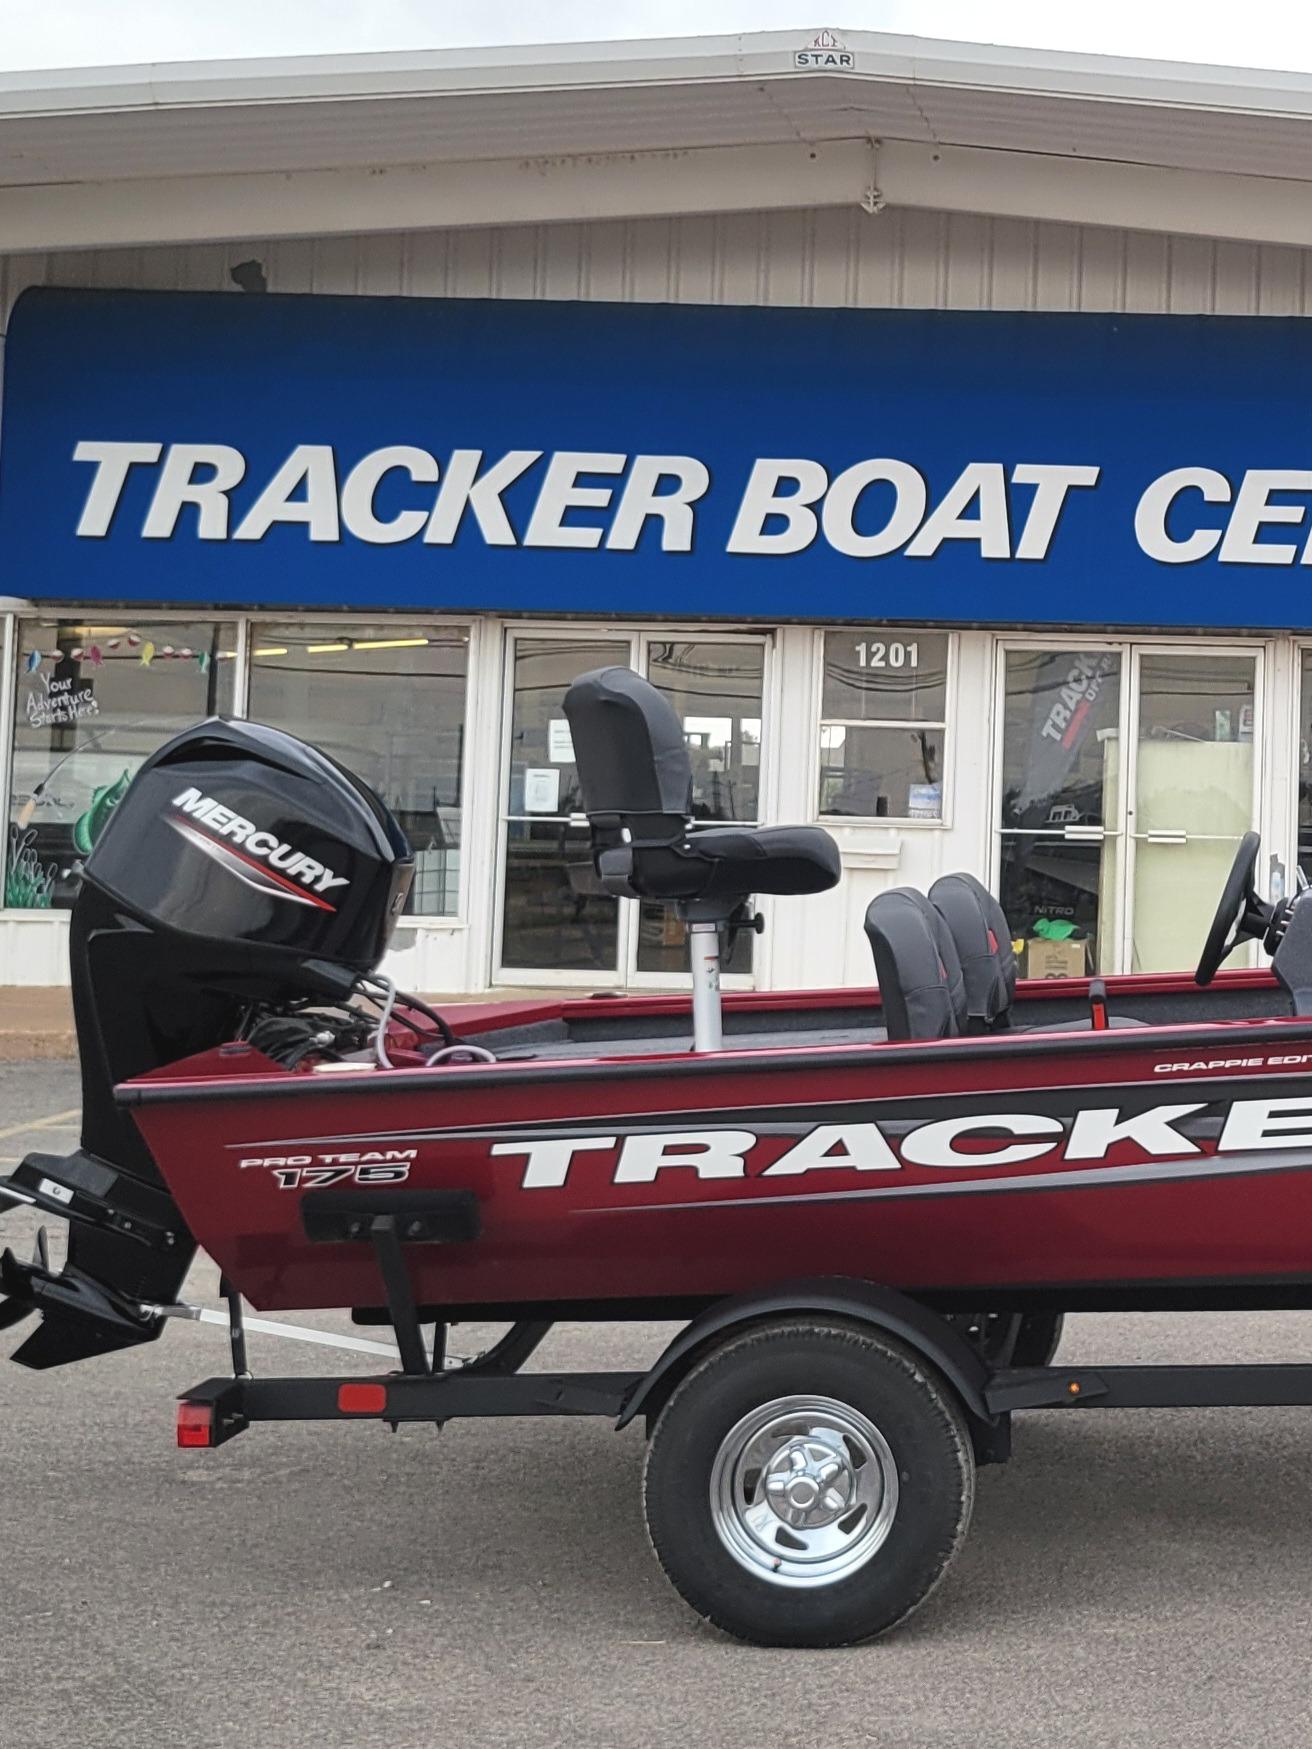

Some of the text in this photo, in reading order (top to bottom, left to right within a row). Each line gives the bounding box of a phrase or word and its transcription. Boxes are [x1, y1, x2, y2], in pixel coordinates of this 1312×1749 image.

[797, 53, 851, 65] STAR
[73, 440, 710, 552] TRACKER
[726, 457, 1099, 560] BOAT
[855, 642, 918, 668] 1201
[40, 672, 73, 694] Your
[27, 689, 94, 714] Adventure
[171, 786, 350, 892] MERCURY
[1153, 1057, 1264, 1073] CRAPPIE
[239, 1149, 418, 1169] PRO TEAM
[272, 1161, 411, 1190] 175
